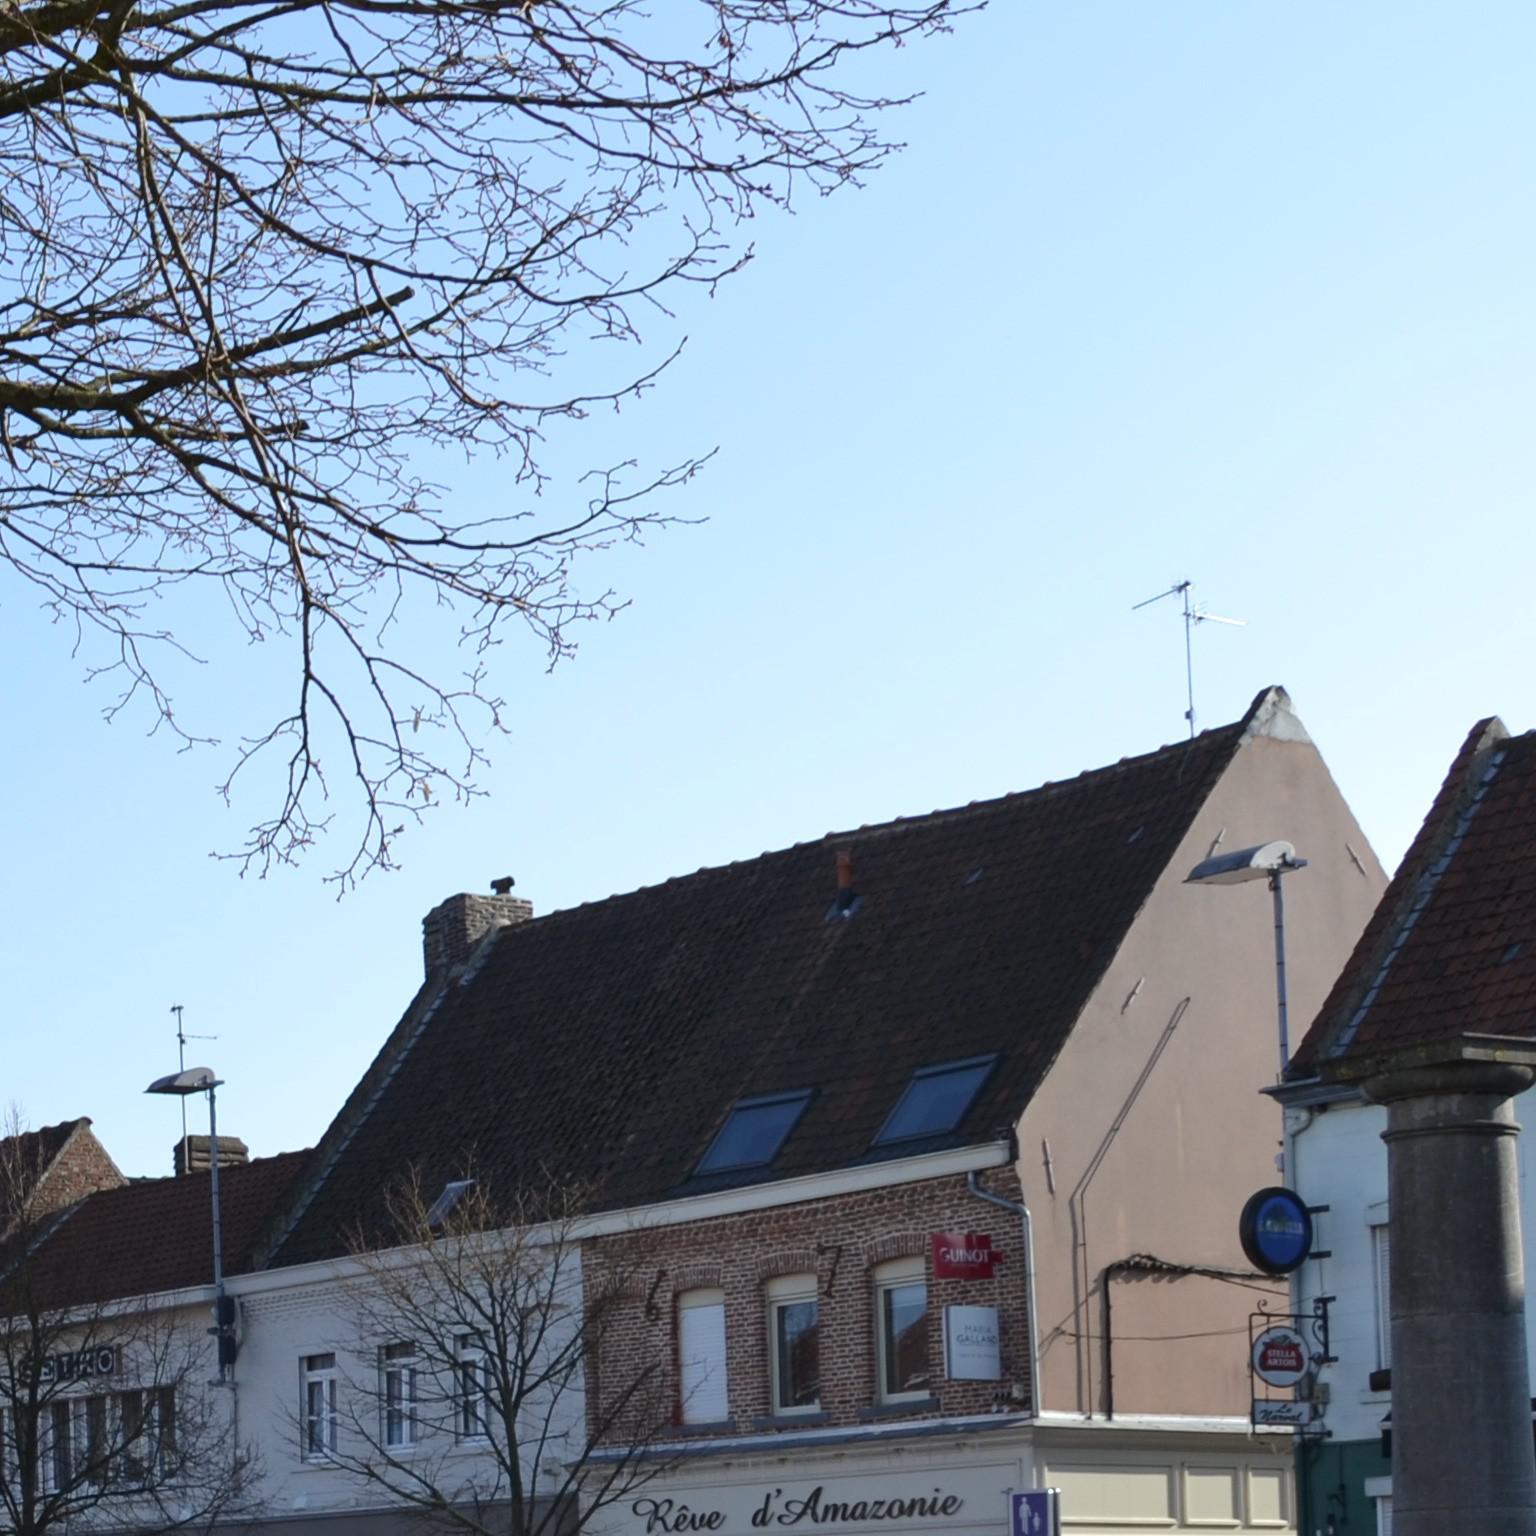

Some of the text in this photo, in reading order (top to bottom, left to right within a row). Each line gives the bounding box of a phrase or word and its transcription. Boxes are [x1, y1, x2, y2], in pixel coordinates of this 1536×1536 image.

[939, 1247, 989, 1264] GUINOT
[1266, 1349, 1297, 1358] STELLA
[1266, 1358, 1297, 1367] ARTOIS
[632, 1486, 965, 1535] Rêve d'Amazonie
